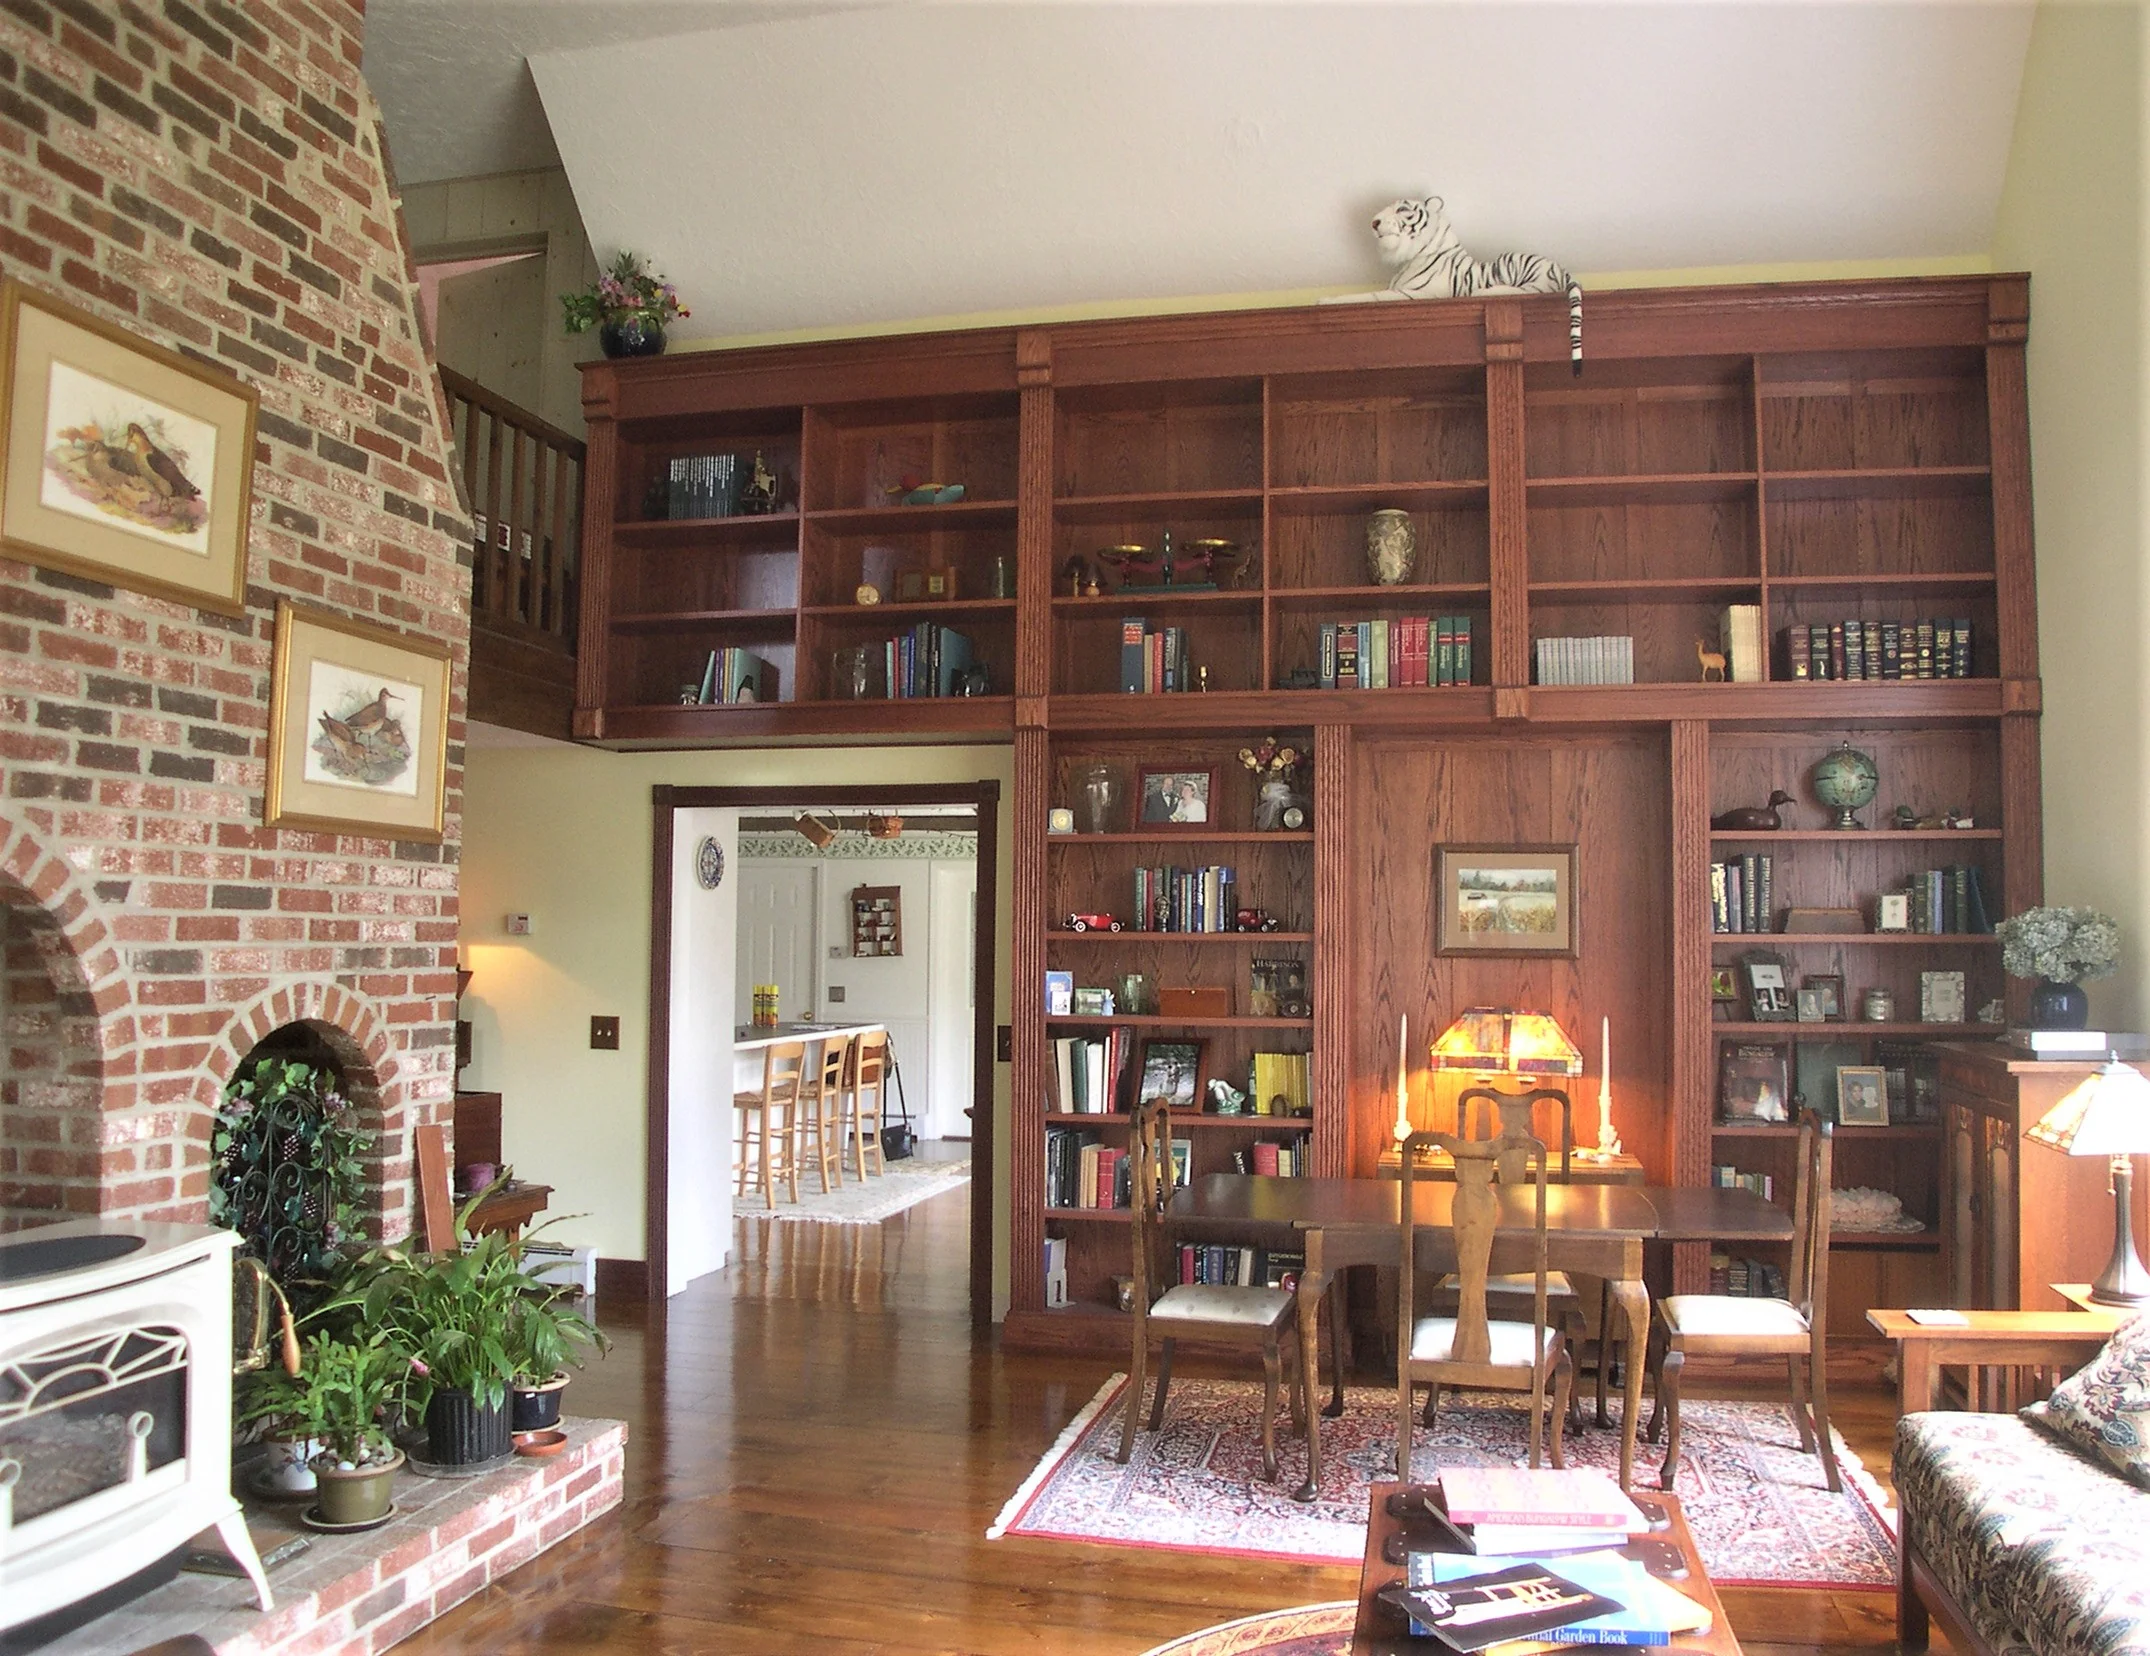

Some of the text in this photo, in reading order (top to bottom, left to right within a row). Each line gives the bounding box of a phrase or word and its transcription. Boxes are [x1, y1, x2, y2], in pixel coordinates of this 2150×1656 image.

[1570, 1514, 1592, 1525] STYLE
[1555, 1629, 1596, 1643] Garden
[1600, 1630, 1628, 1644] Book
